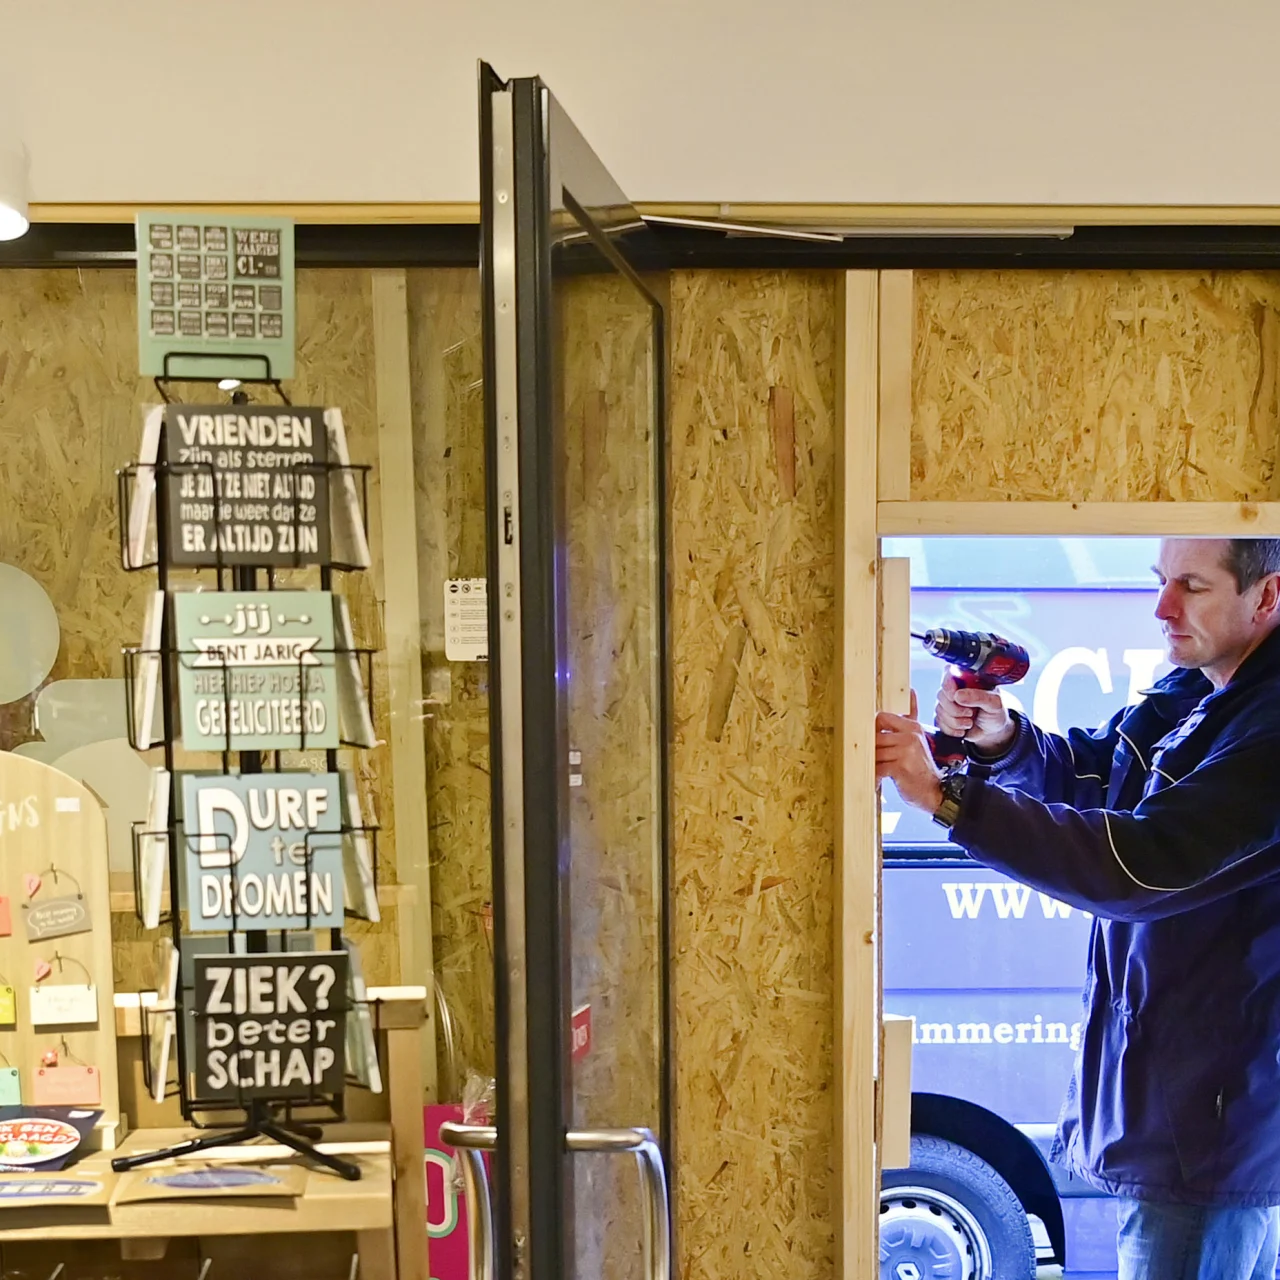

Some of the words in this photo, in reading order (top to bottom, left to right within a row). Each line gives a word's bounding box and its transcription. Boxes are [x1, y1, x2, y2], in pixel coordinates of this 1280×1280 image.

[236, 244, 278, 256] KAARTEN
[176, 414, 313, 447] VRIENDEN
[217, 449, 242, 468] als
[246, 450, 313, 468] sterren
[180, 474, 195, 498] JE
[225, 472, 241, 497] ZE
[243, 473, 270, 499] NIET
[180, 502, 214, 521] maar
[218, 500, 232, 522] je
[234, 503, 270, 521] weet
[298, 504, 316, 522] ze
[182, 524, 206, 552] ER
[210, 524, 273, 552] ALTIJD
[277, 525, 318, 553] ZIJN
[232, 603, 271, 636] jij
[207, 644, 247, 661] BENT
[231, 671, 265, 693] HIEP
[197, 787, 328, 868] DURF
[270, 837, 312, 866] te
[205, 964, 337, 1015] ZIEK?
[207, 1018, 336, 1049] beter
[886, 1013, 1083, 1051] immering
[206, 1048, 335, 1090] SCHAP
[19, 1124, 61, 1134] BEN
